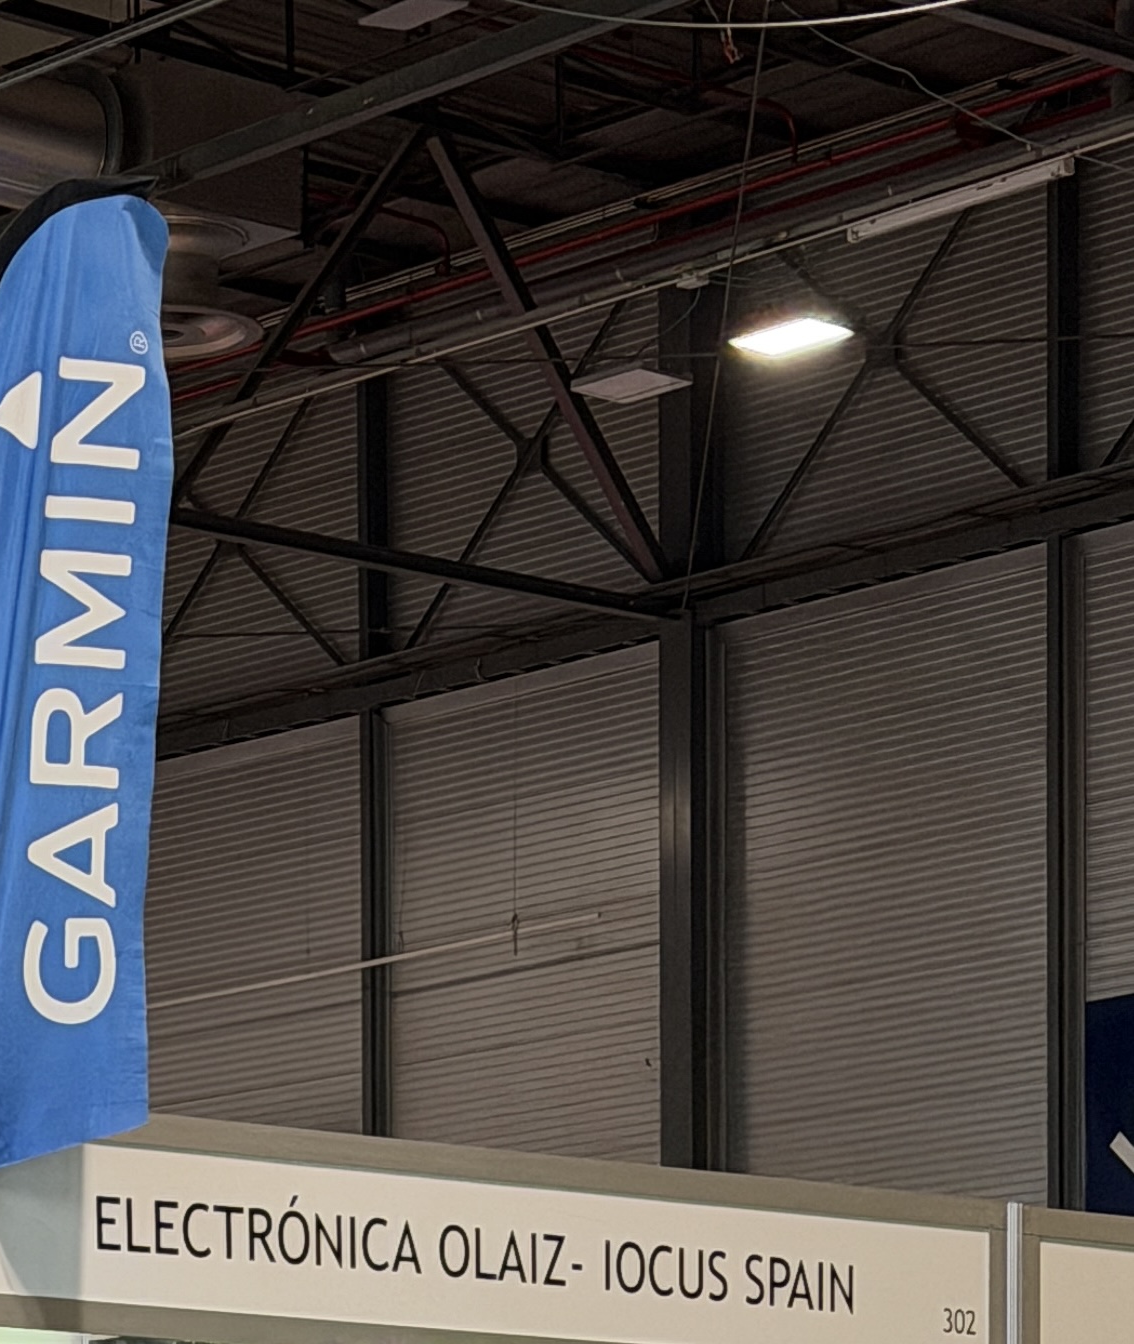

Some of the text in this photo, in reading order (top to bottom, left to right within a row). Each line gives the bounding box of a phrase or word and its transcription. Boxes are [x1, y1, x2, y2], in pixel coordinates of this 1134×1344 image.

[22, 356, 147, 1025] GARMIN
[95, 1195, 855, 1315] ELECTRÓNICA OLAIZ- IOCUS SPAIN
[942, 1307, 977, 1336] 302
